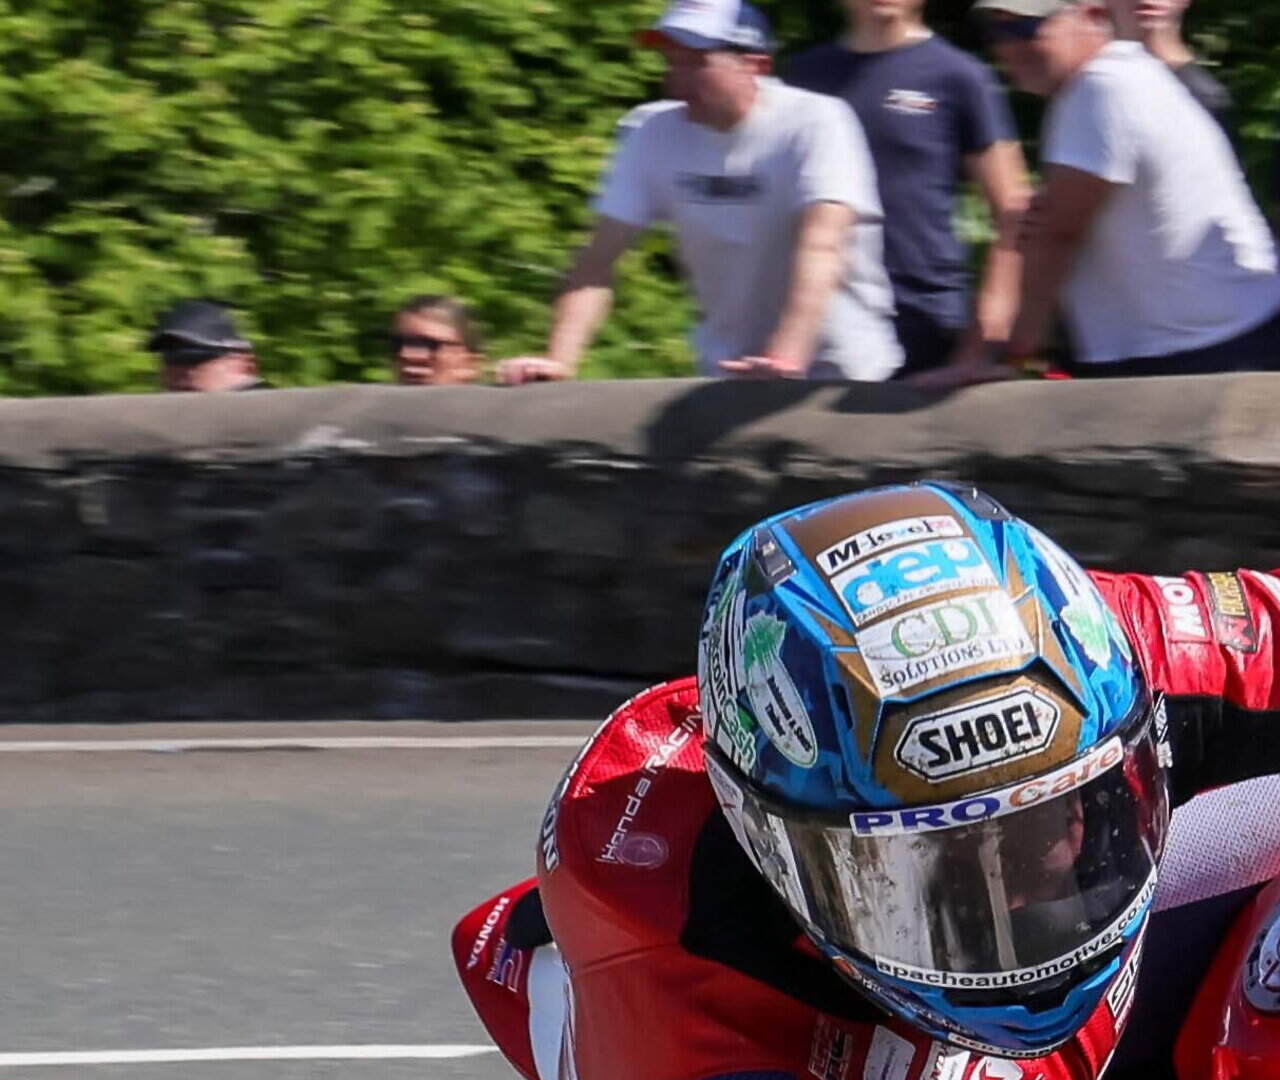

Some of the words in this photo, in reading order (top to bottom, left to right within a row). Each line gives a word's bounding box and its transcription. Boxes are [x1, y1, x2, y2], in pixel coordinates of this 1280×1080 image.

[891, 598, 1000, 658] CDI
[1152, 576, 1206, 638] MOT
[879, 641, 985, 690] SOLUTIONS
[645, 705, 701, 774] RACIN
[918, 702, 1042, 768] SHOEI
[466, 897, 510, 971] HONDA
[877, 880, 1157, 987] apacheautomotive.co.uk
